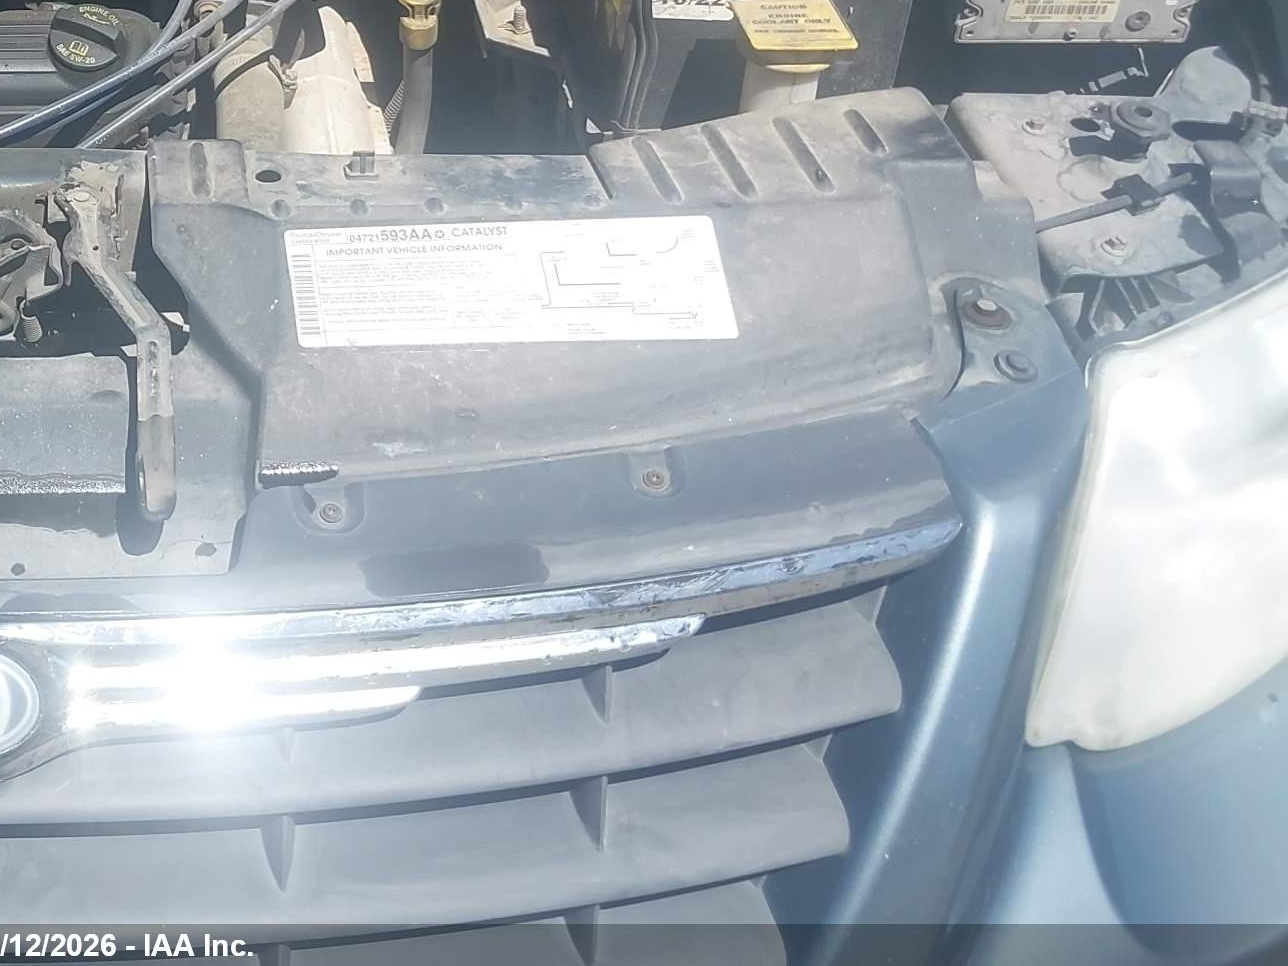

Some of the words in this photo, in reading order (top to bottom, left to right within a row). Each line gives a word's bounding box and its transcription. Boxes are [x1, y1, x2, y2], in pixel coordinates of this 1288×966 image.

[79, 5, 110, 17] ENGINE
[108, 14, 120, 27] OIL
[56, 43, 71, 57] SAE
[70, 53, 96, 64] 5W-20
[451, 226, 508, 237] CATALYST
[326, 246, 385, 257] IMPORTANT
[385, 244, 428, 255] VEHICLE
[430, 243, 503, 253] INFORMATION
